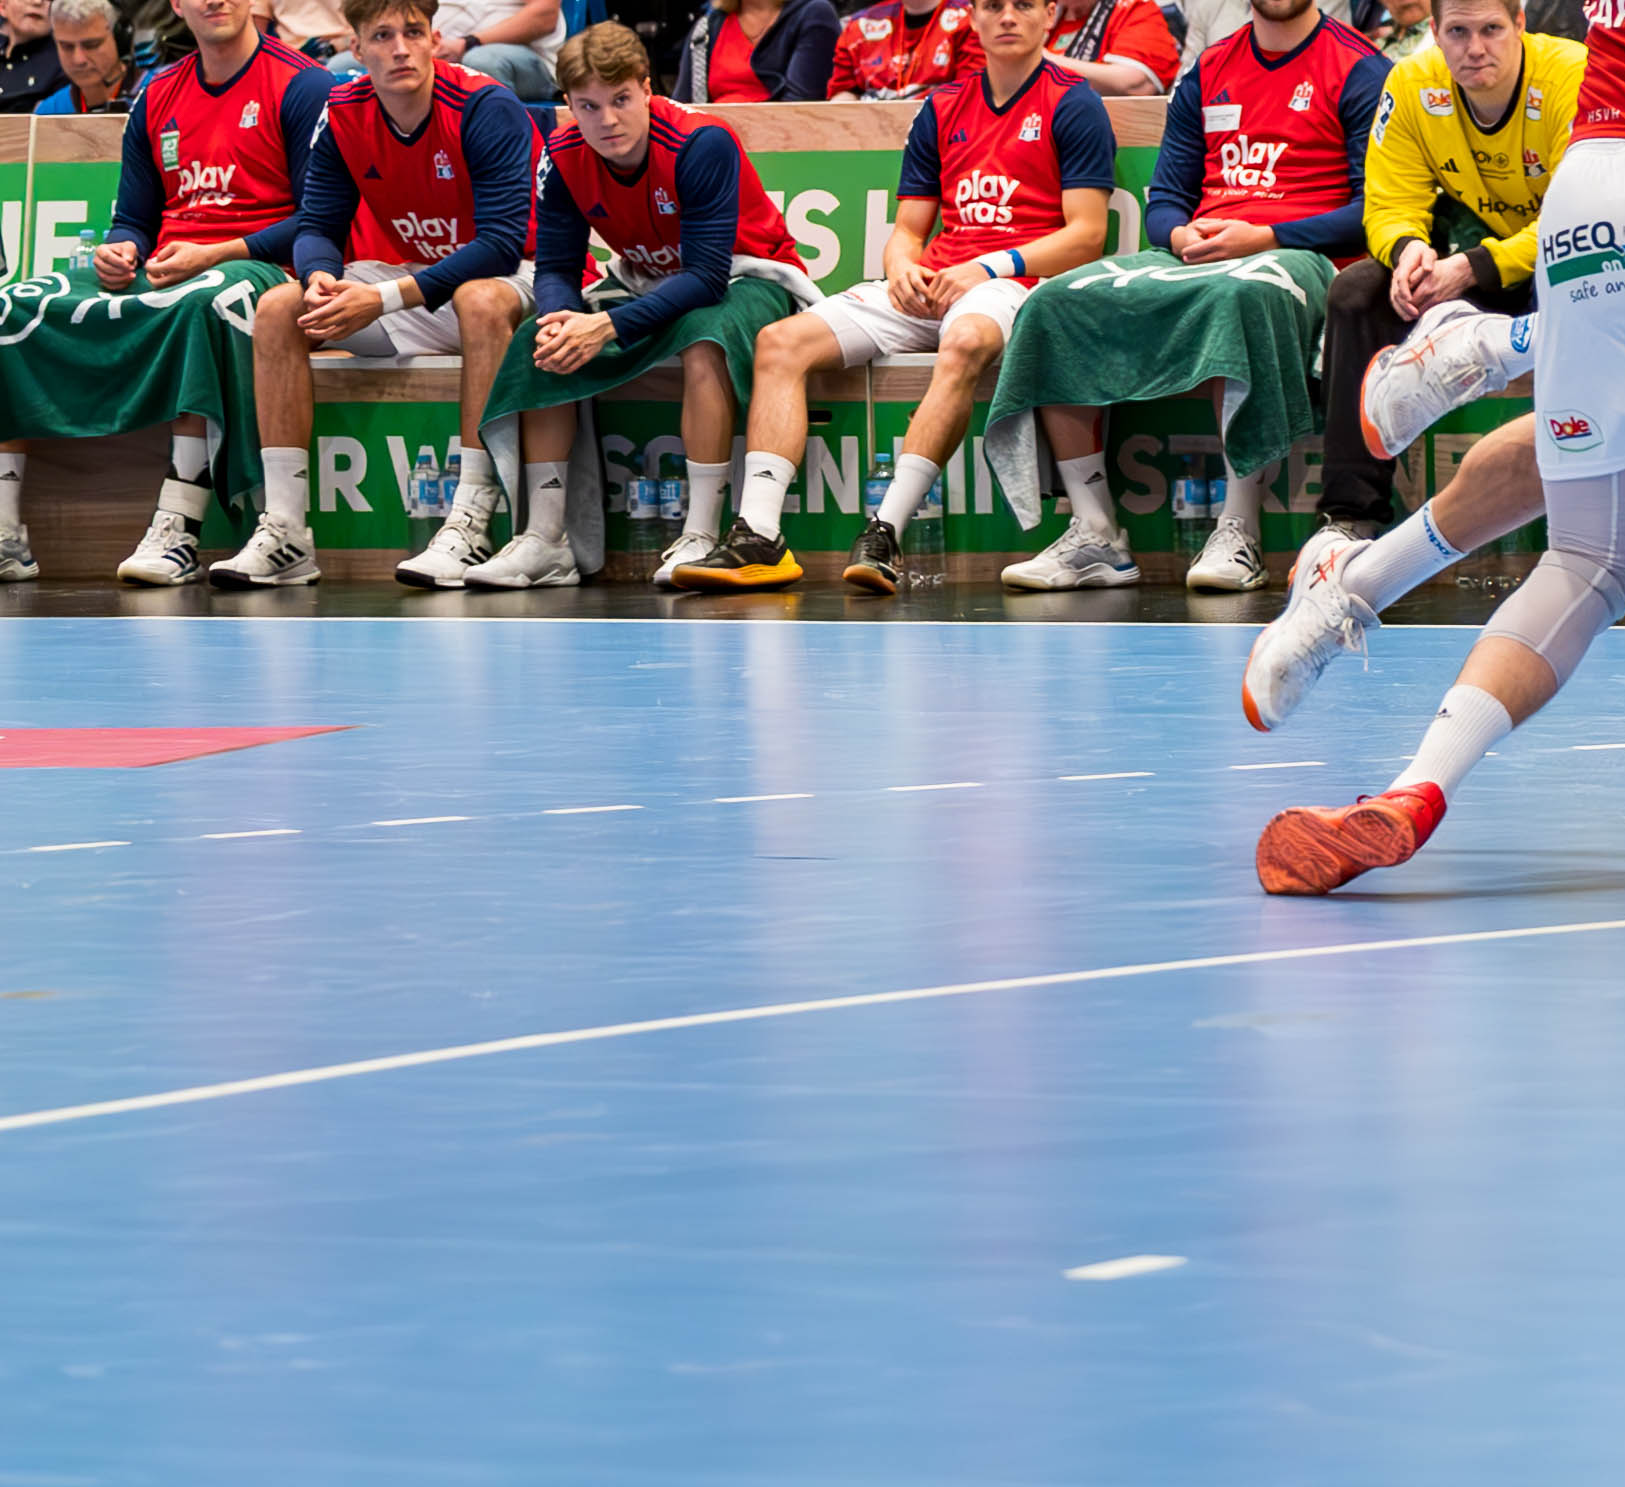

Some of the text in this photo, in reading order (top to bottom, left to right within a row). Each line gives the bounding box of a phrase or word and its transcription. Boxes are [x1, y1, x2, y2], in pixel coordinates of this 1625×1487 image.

[1221, 134, 1288, 169] play
[178, 161, 236, 198] play
[955, 169, 1020, 210] play
[393, 211, 457, 243] play
[1569, 280, 1599, 303] safe
[1550, 416, 1590, 438] Dole
